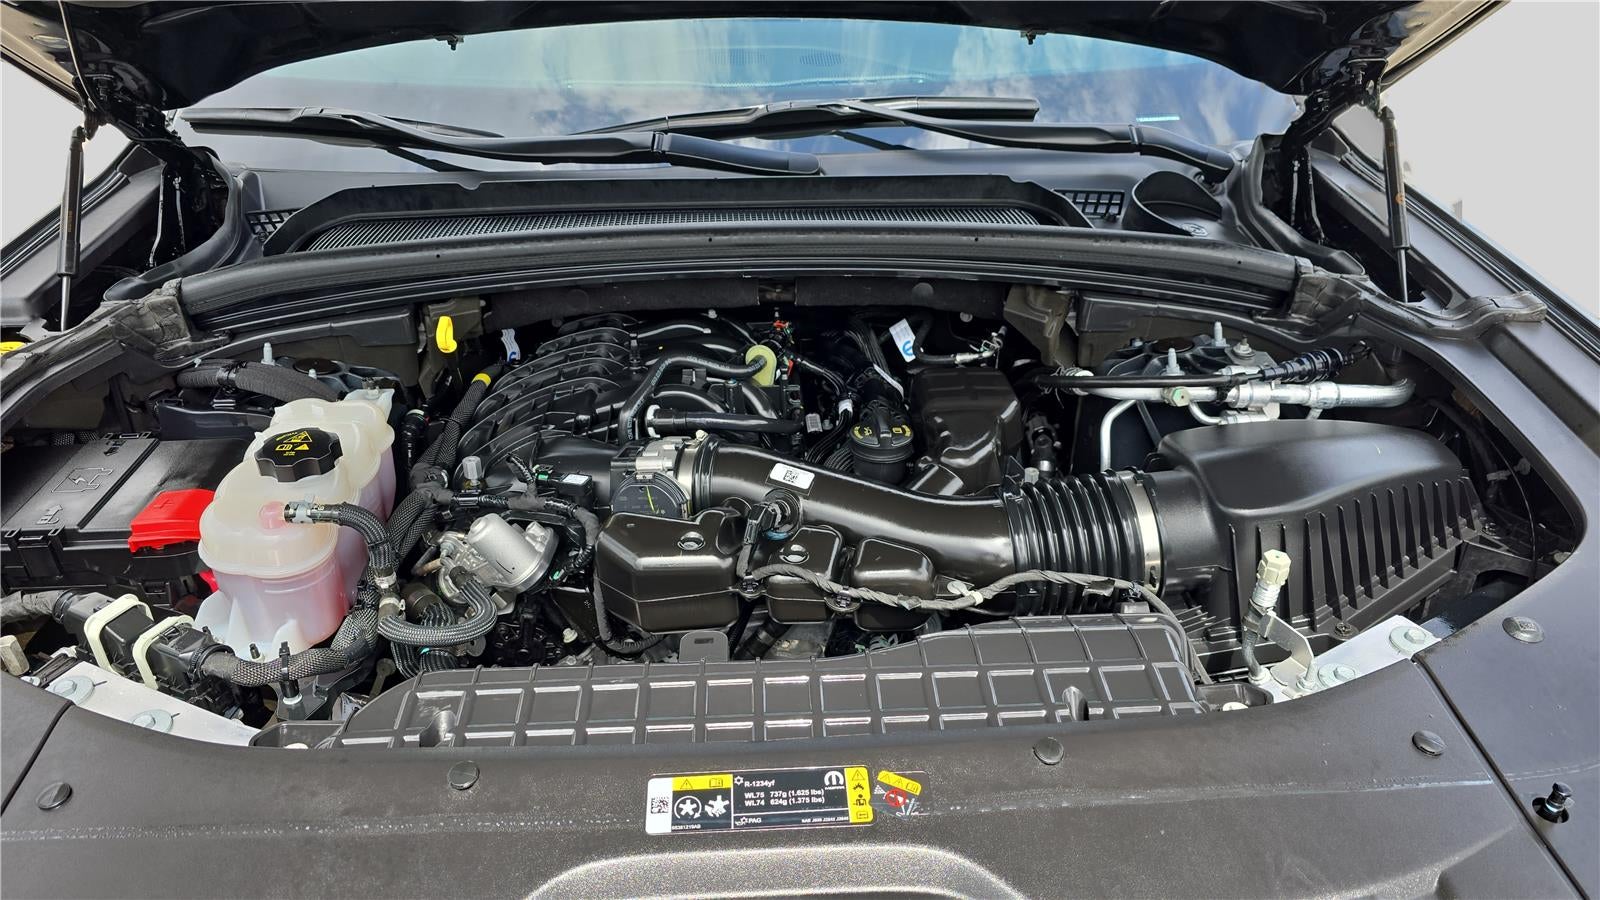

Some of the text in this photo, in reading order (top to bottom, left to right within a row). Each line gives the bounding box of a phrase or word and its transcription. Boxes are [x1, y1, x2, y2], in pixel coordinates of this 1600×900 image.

[744, 779, 775, 788] R-1234yf
[744, 788, 825, 799] WL75 737g (1.625 lbs)
[789, 797, 810, 805] (1.375
[811, 796, 825, 804] lbs)
